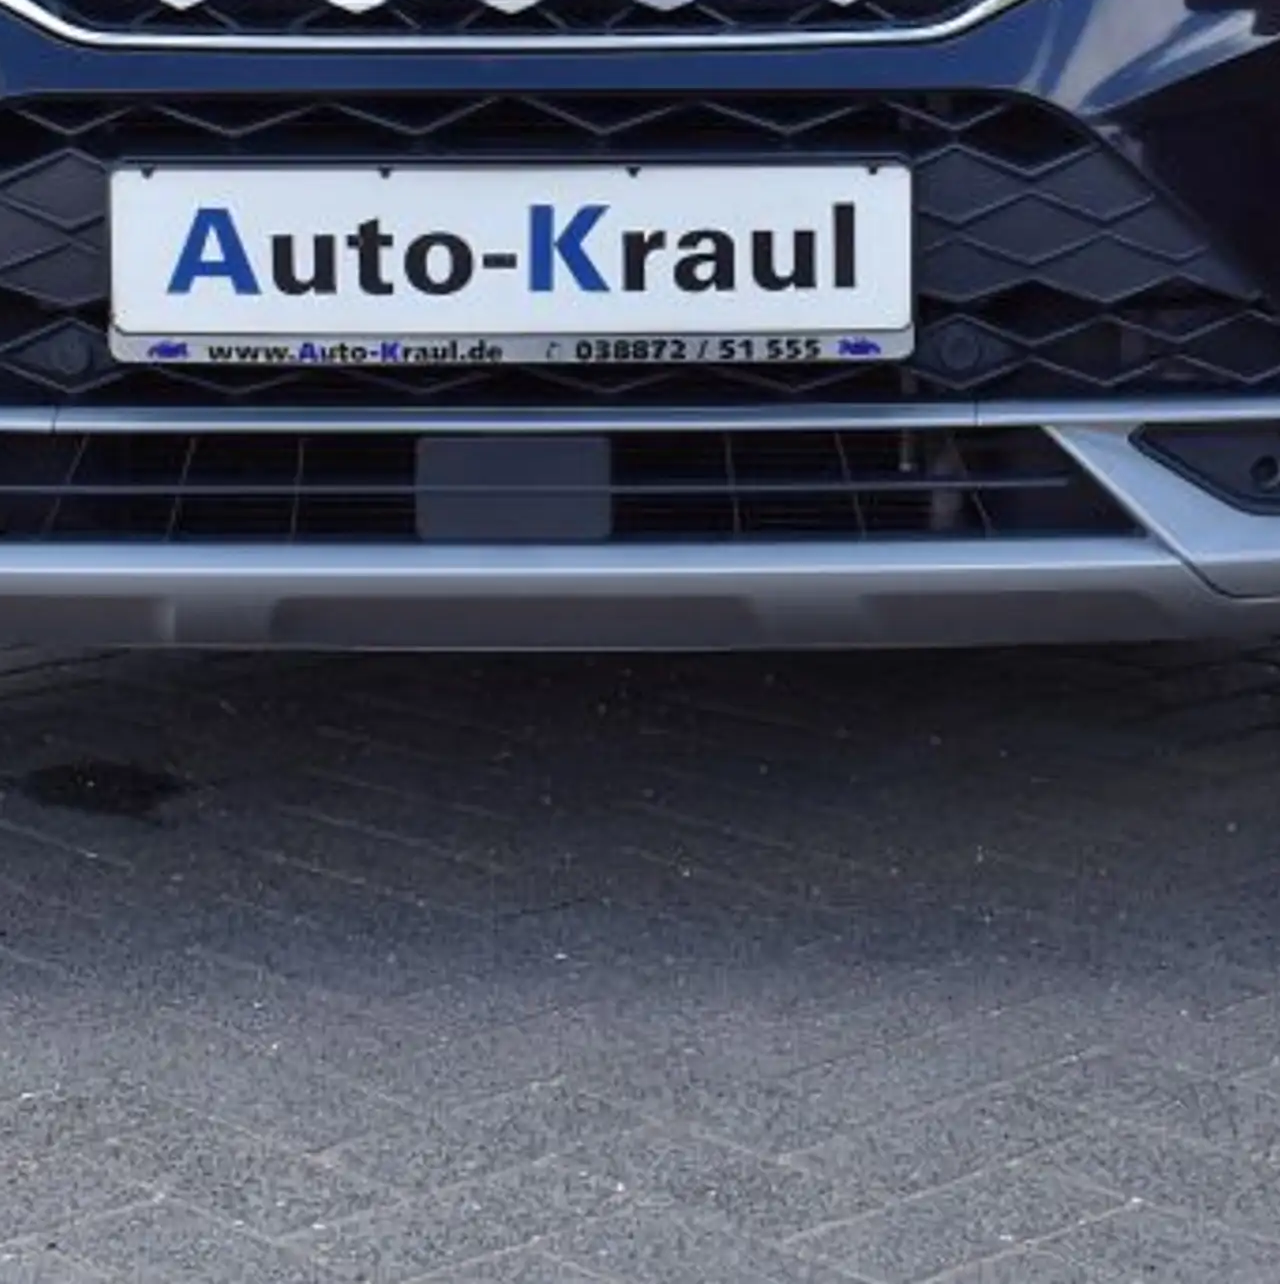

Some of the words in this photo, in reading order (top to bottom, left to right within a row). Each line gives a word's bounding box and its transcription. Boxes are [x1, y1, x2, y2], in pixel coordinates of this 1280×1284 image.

[166, 203, 856, 296] Auto-Kraul
[207, 339, 504, 363] www.Auto-Kraul.de
[575, 338, 687, 360] 038872
[719, 338, 755, 360] 51
[766, 337, 822, 359] 555
